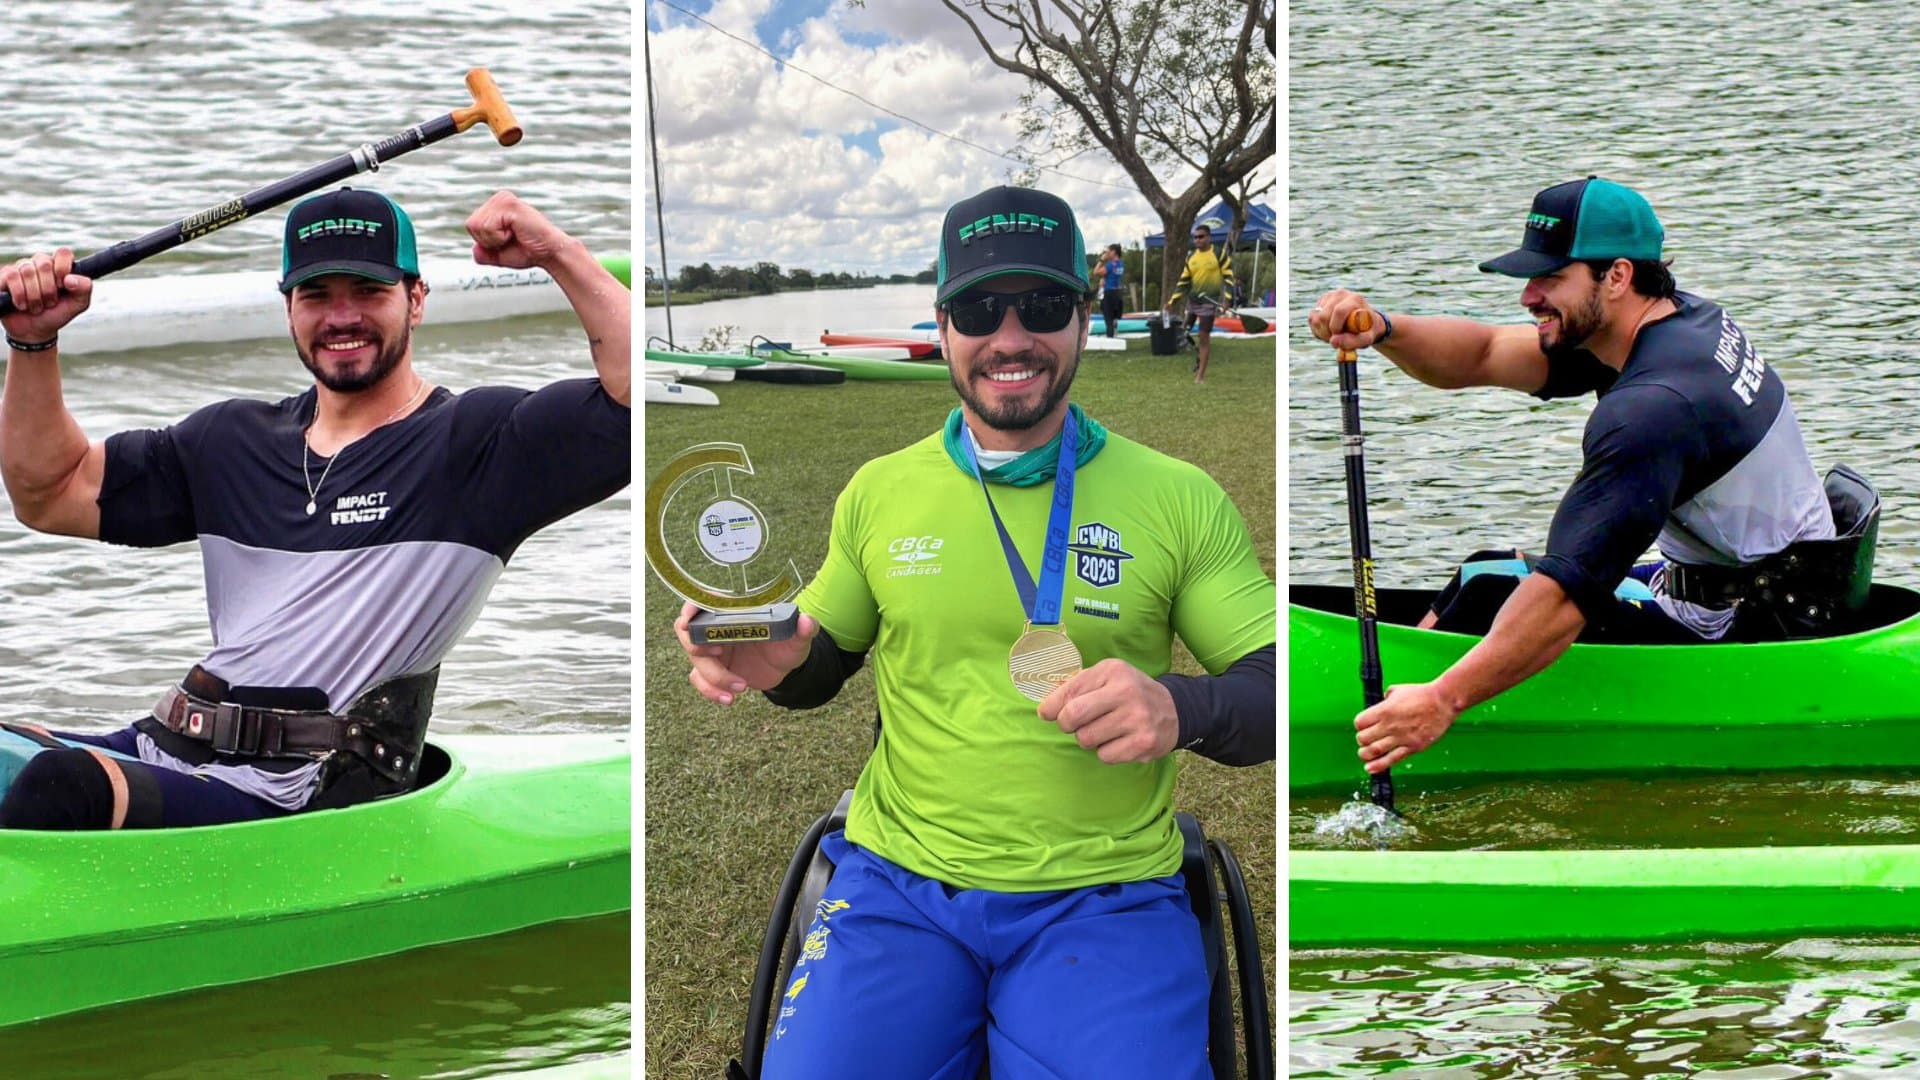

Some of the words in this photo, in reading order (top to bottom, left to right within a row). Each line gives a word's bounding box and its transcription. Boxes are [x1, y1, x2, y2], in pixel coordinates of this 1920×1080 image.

[297, 218, 382, 243] FENDT
[958, 212, 1059, 246] FENDT
[336, 491, 388, 510] IMPACT
[331, 506, 391, 525] FENDT
[1079, 526, 1119, 549] CWB
[1081, 555, 1116, 583] 2026
